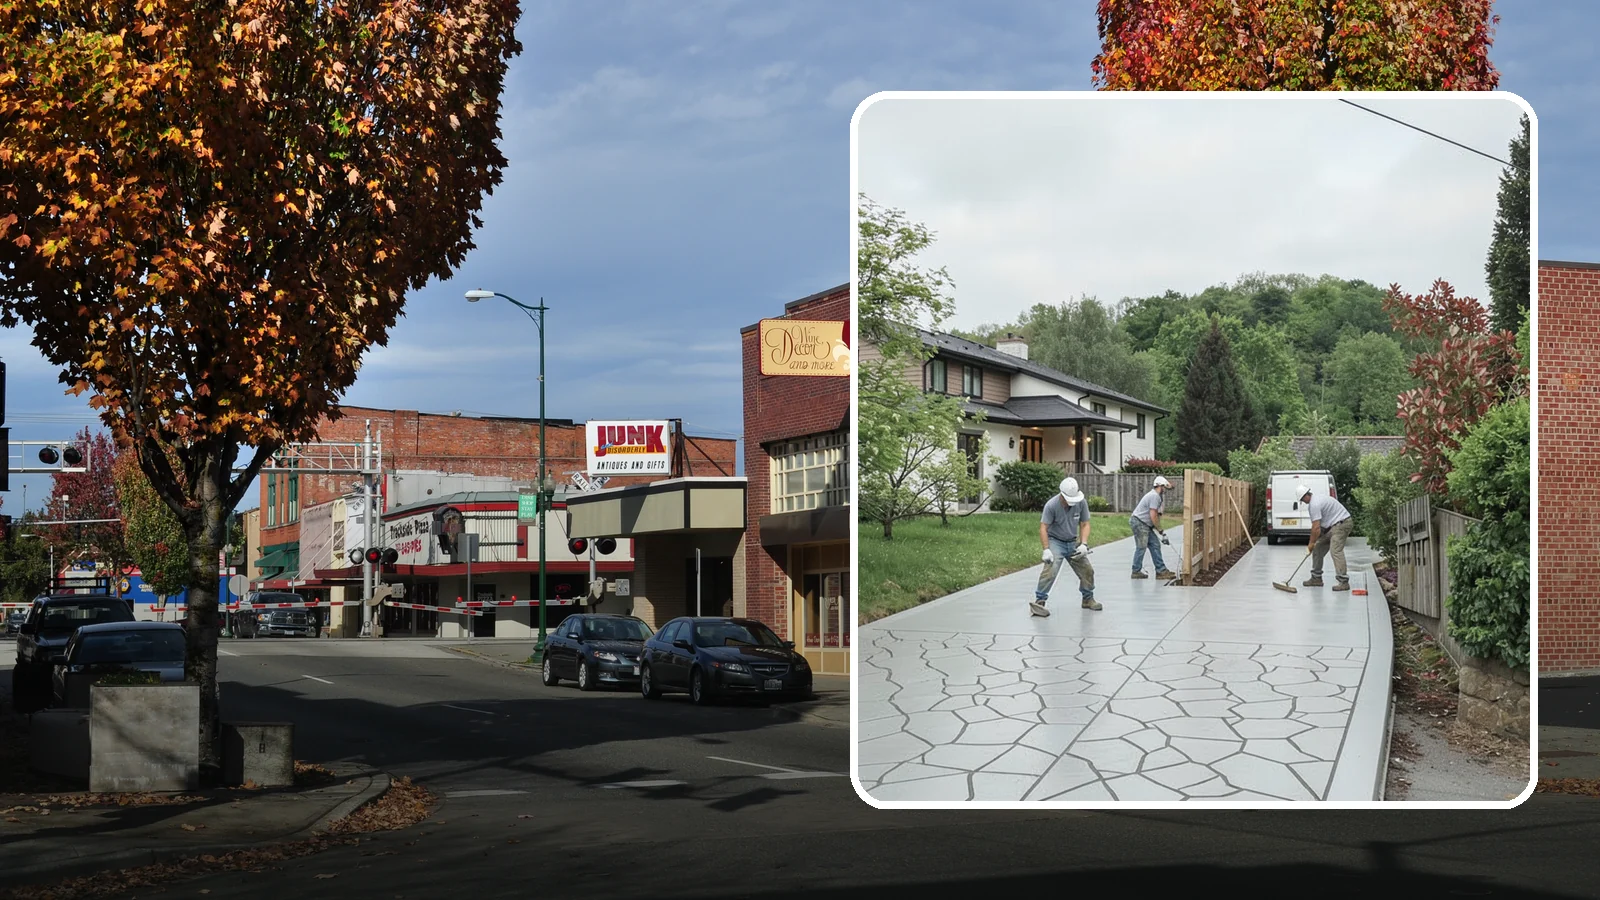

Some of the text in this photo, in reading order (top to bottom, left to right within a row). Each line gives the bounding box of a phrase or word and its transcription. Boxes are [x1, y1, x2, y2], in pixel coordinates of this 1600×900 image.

[765, 327, 831, 365] Decor
[596, 425, 665, 457] JUNK
[597, 460, 665, 470] ANTIQUES AND GIFTS
[352, 498, 365, 511] CRO
[390, 519, 429, 539] Trackside Pizza
